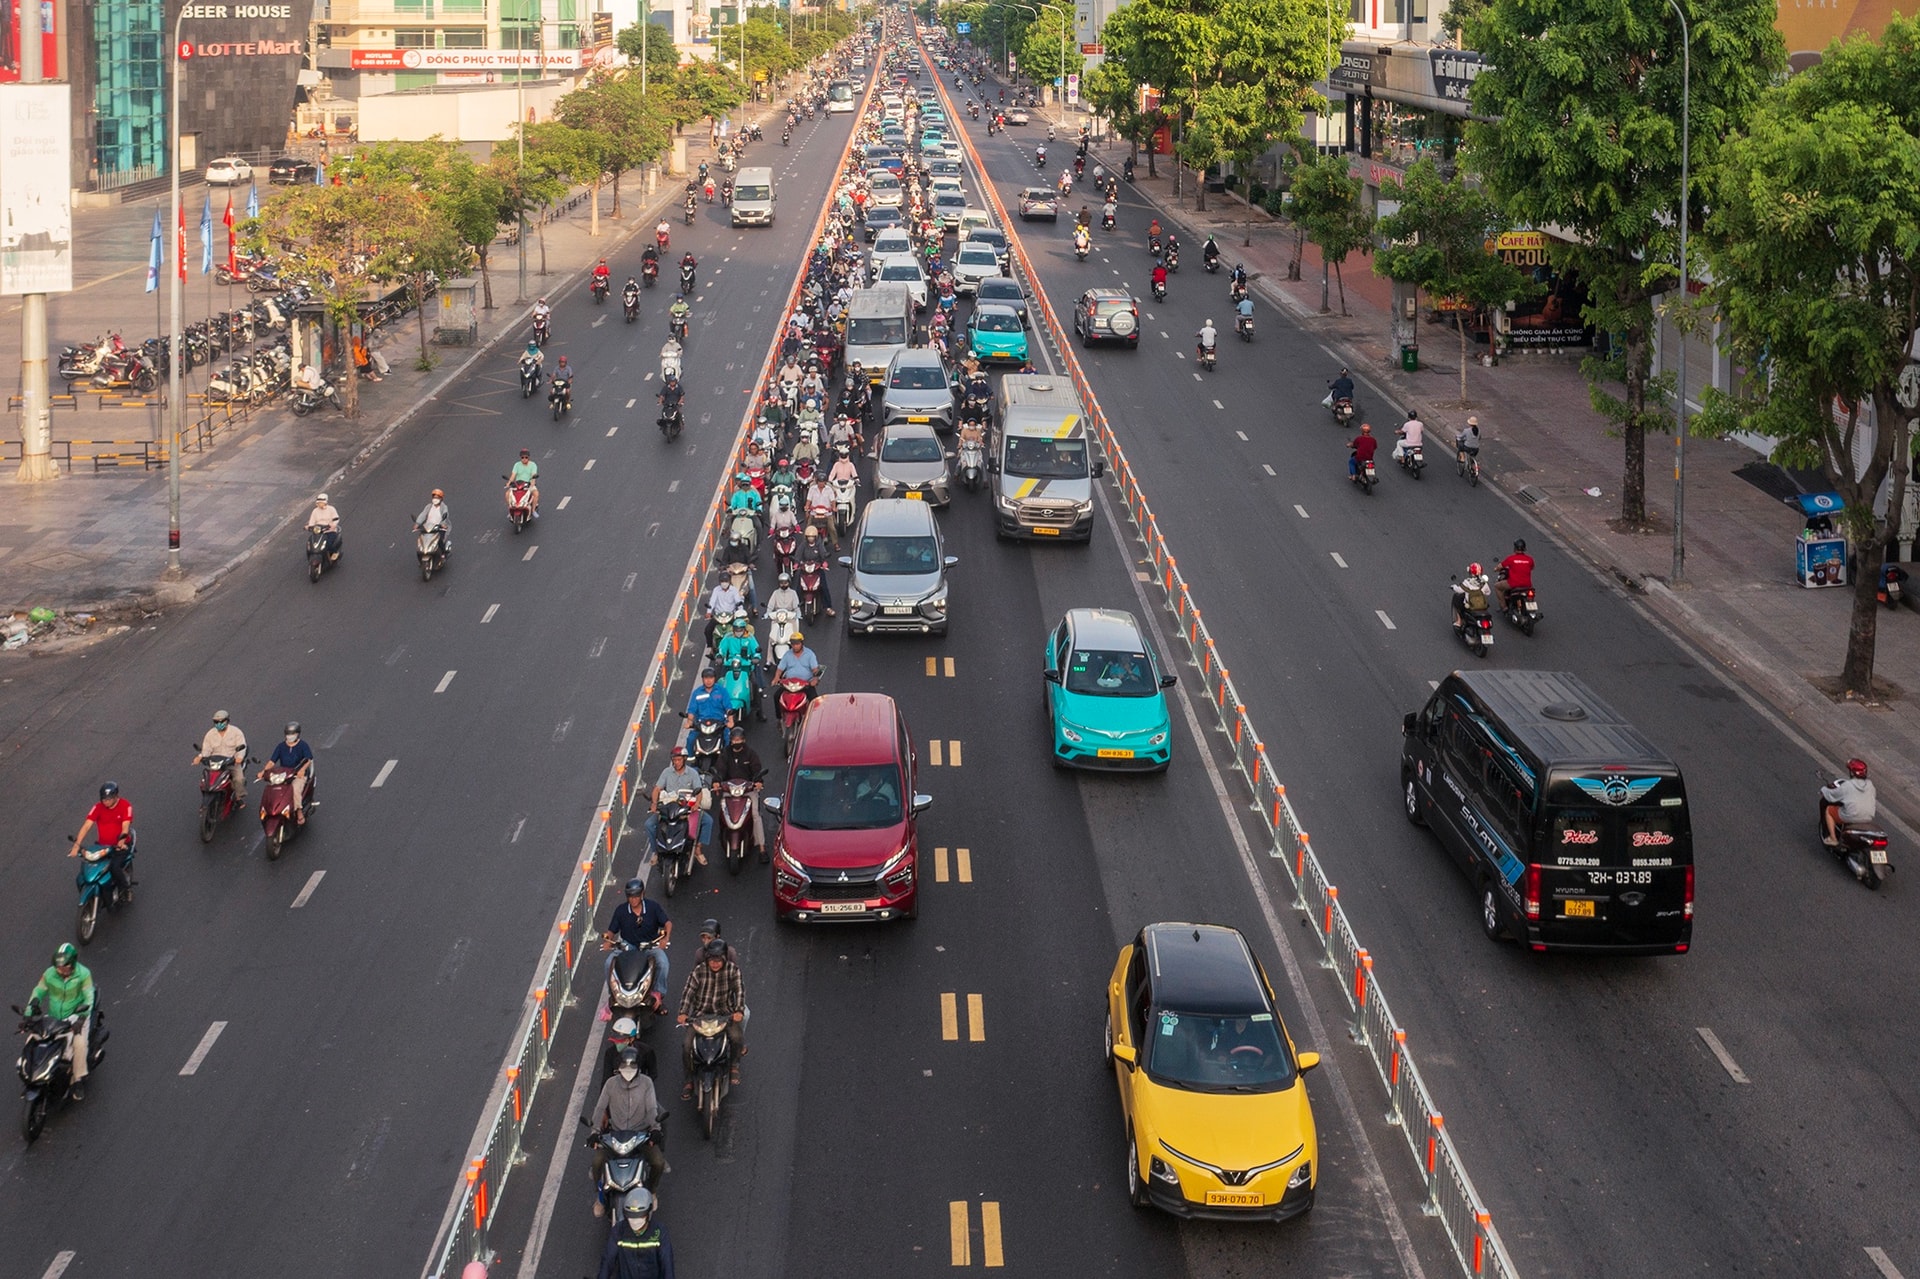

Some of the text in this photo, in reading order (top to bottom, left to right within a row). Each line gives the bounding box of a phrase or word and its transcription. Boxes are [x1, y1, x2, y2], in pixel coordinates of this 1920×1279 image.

[182, 5, 291, 18] BEER HOUSE
[198, 40, 301, 56] LOTTE Mart
[1503, 250, 1548, 266] ACOU
[1460, 805, 1498, 854] SOLATI
